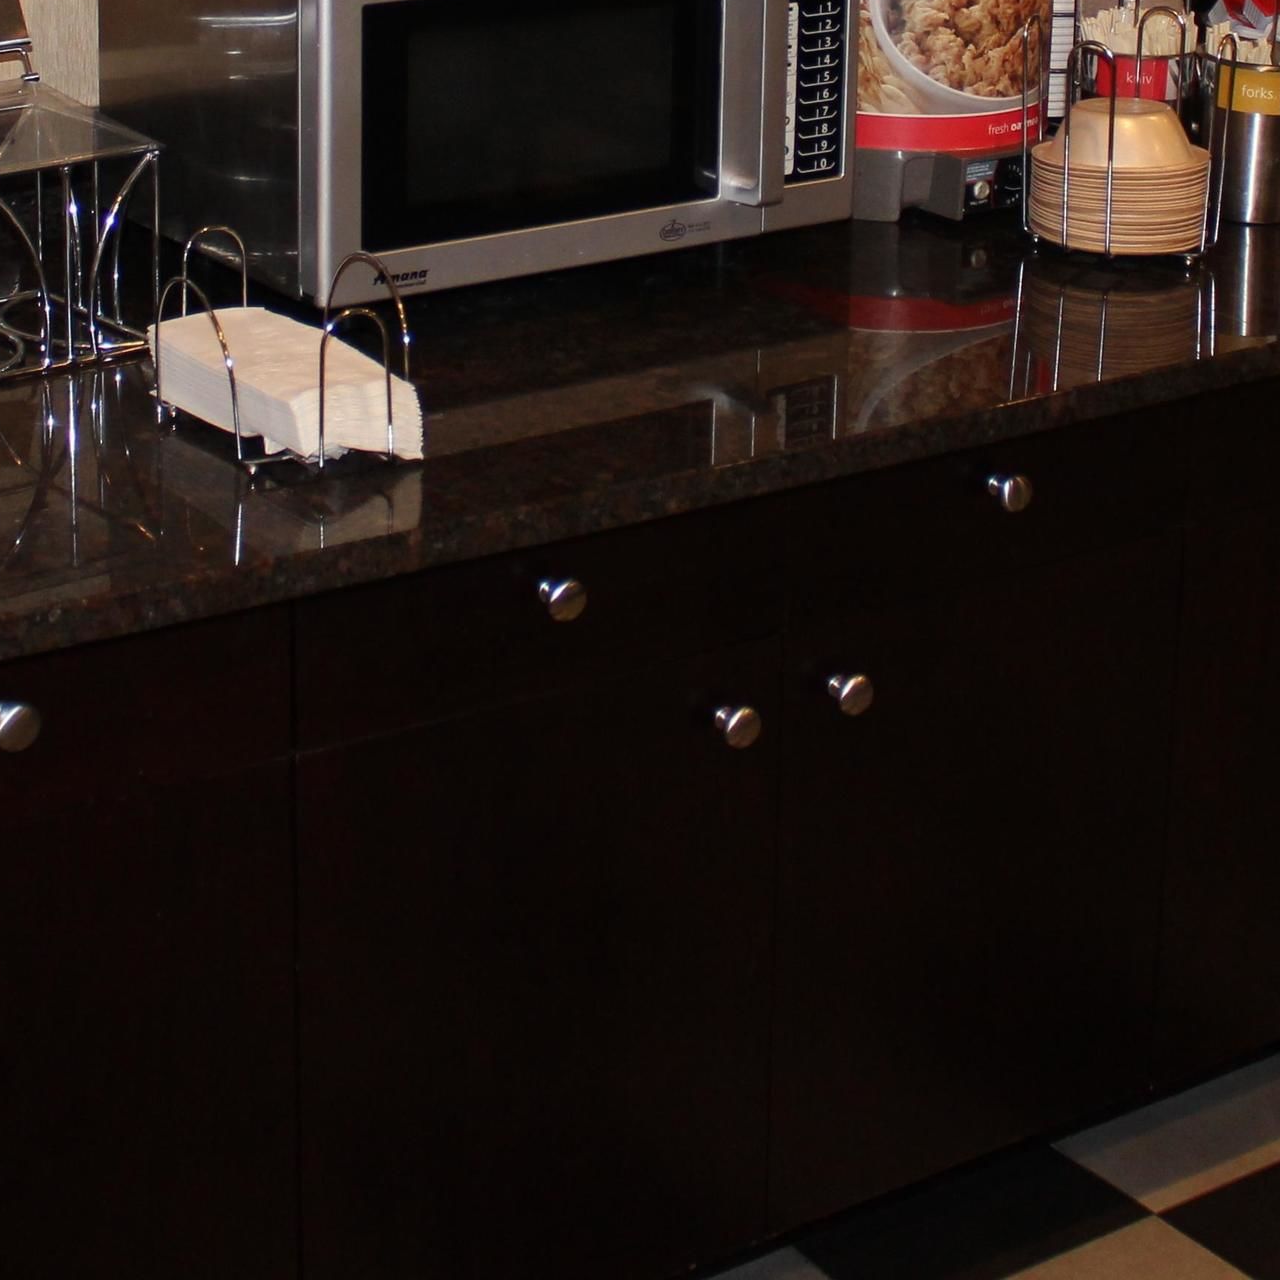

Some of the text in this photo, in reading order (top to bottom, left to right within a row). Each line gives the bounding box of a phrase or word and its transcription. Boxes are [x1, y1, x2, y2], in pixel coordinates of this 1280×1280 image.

[826, 1, 832, 12] 1
[825, 19, 832, 29] 2
[824, 36, 831, 47] 3
[823, 54, 830, 65] 4
[823, 71, 830, 81] 5
[822, 88, 829, 98] 6
[1242, 83, 1274, 100] forks
[822, 106, 829, 116] 7
[821, 123, 828, 133] 8
[988, 123, 1009, 136] fresh
[821, 140, 828, 151] 9
[820, 158, 827, 169] 0
